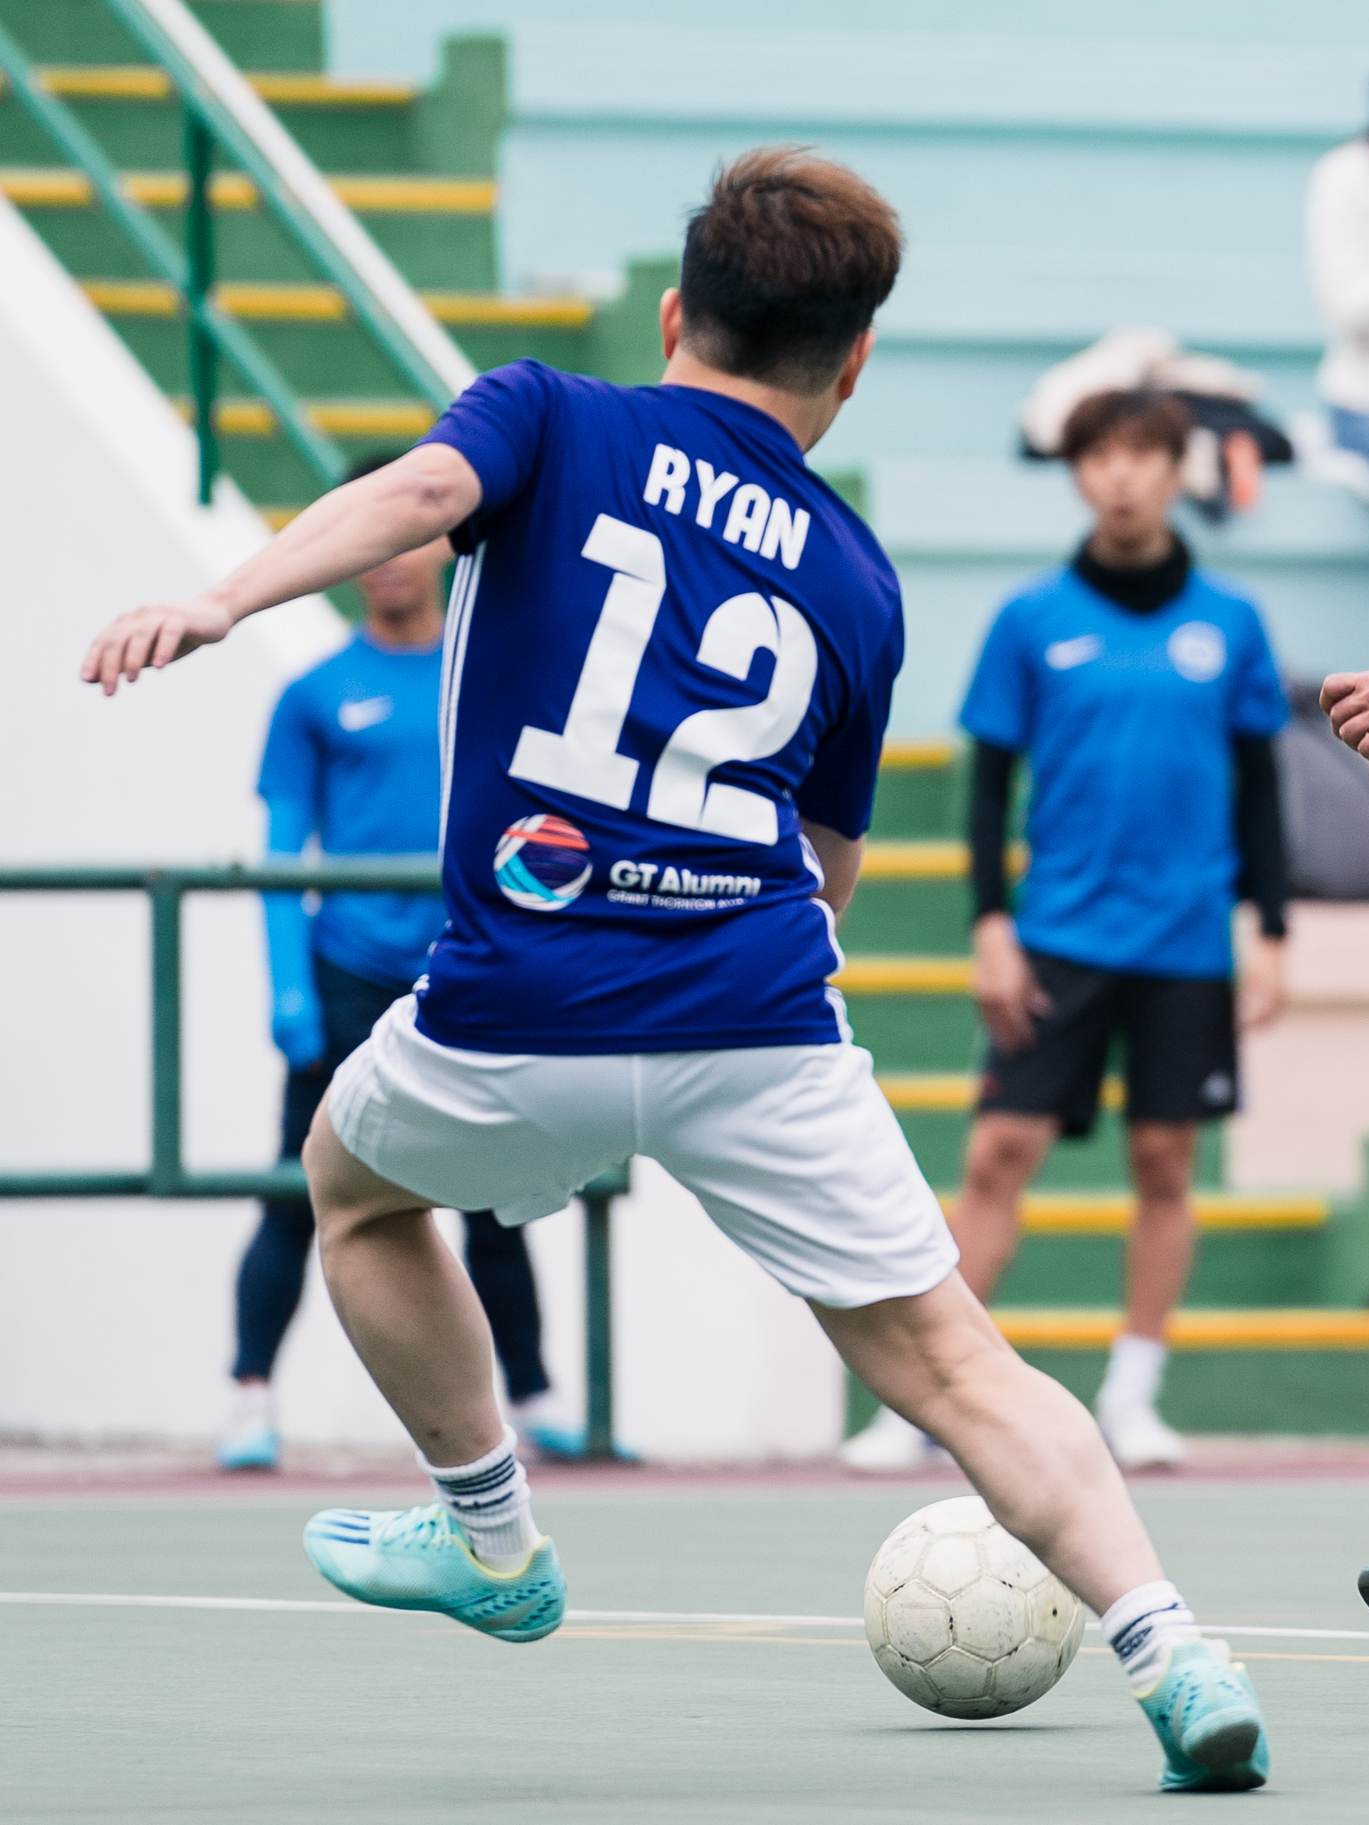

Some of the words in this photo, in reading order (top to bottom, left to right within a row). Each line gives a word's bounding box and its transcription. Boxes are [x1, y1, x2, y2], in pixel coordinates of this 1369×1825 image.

[643, 443, 811, 570] RYAN
[508, 512, 819, 846] 12
[610, 859, 659, 890] GT
[657, 866, 762, 897] Alumni
